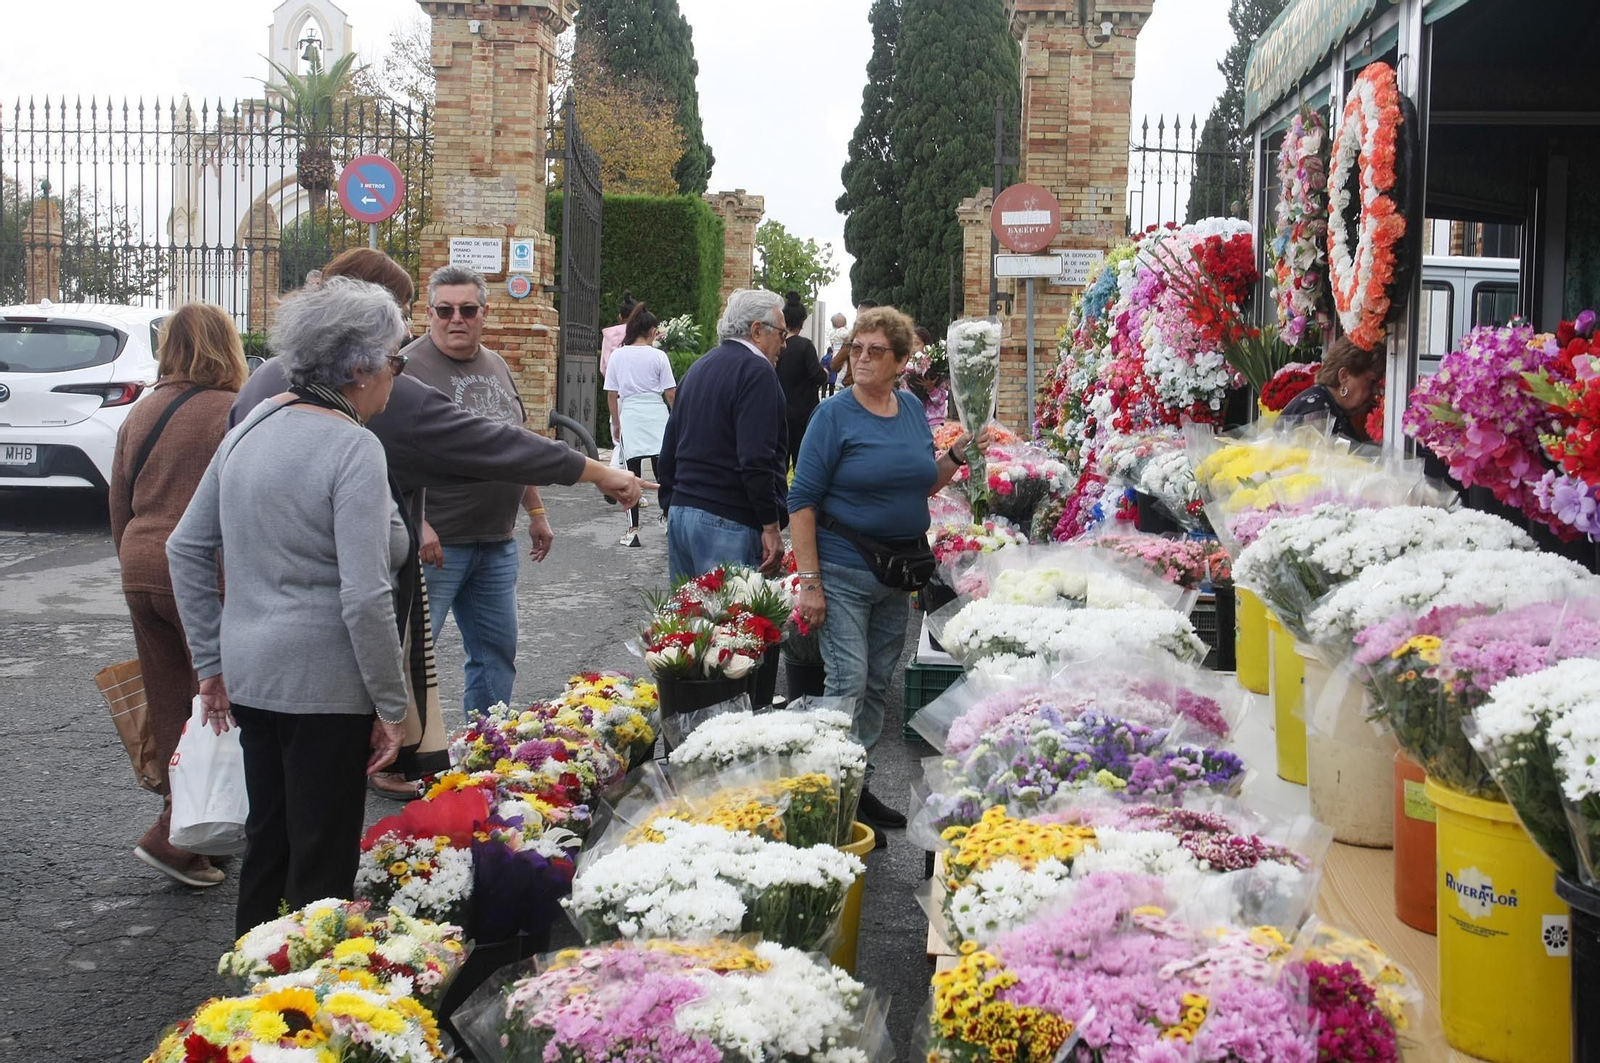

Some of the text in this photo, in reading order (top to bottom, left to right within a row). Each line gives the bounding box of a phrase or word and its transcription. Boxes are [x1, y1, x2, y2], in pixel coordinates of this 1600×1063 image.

[1007, 226, 1046, 234] EXCEPTO
[455, 374, 478, 404] SUPERIOR
[5, 446, 33, 461] MHB
